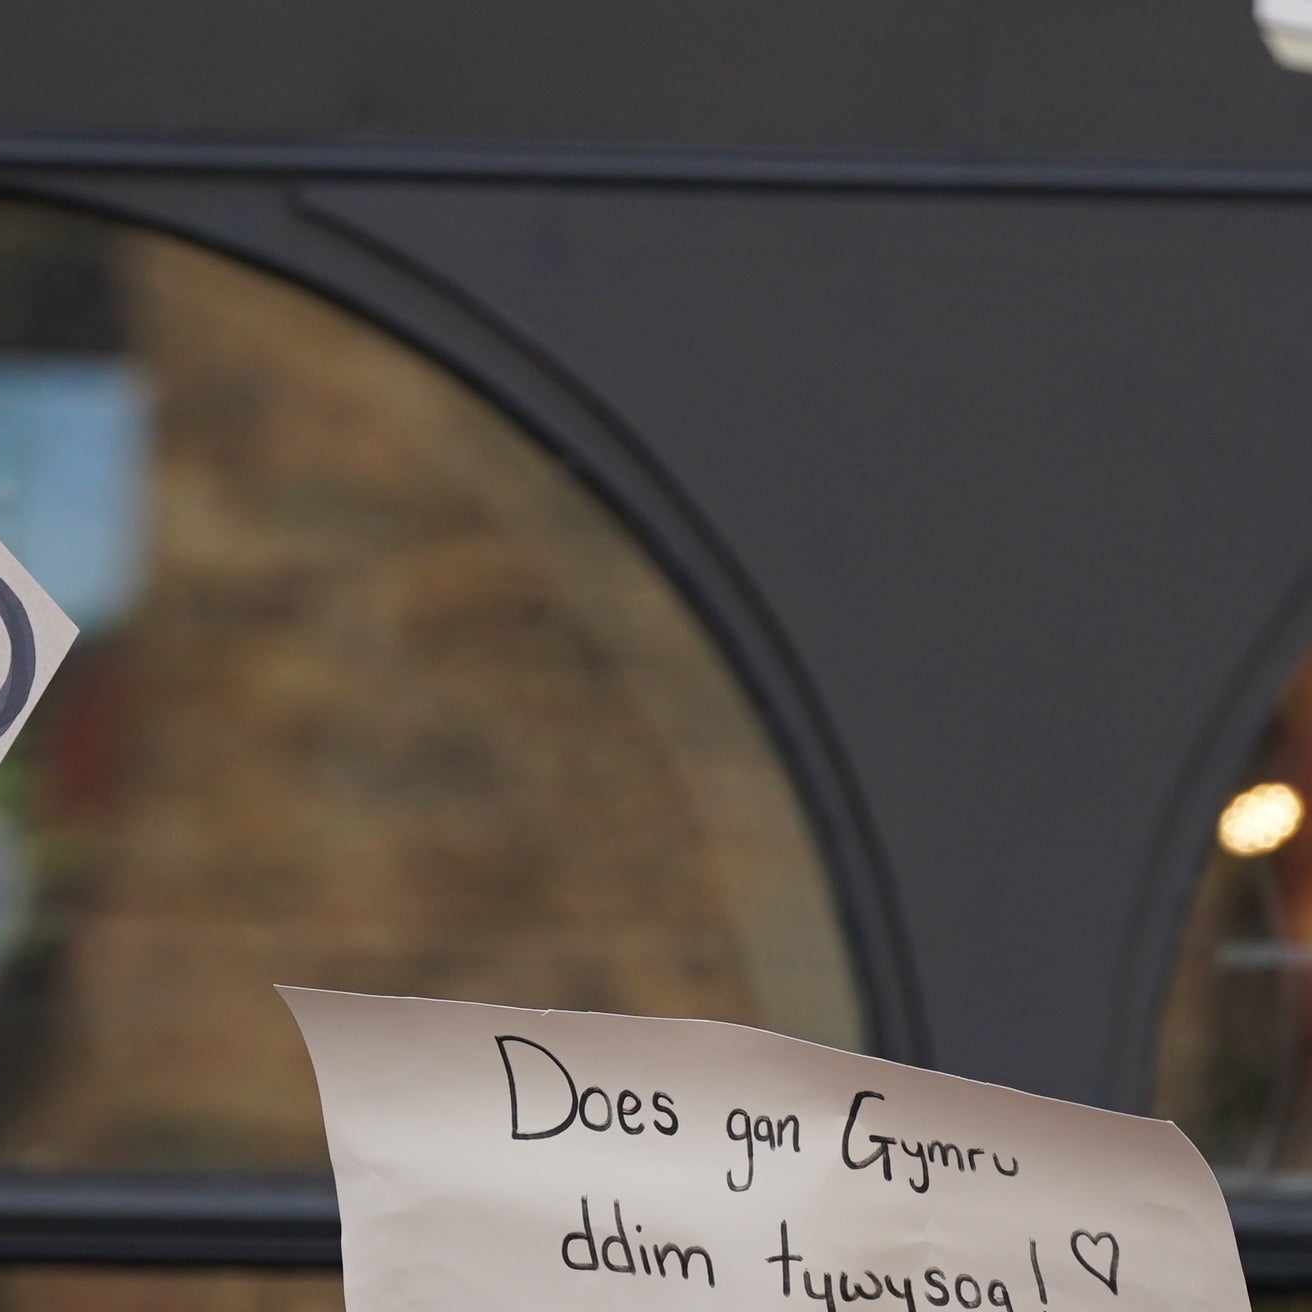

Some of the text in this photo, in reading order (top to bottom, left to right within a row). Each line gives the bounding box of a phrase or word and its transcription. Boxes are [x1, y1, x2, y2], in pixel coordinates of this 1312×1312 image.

[494, 1034, 1020, 1194] Does gan Gymru
[561, 1194, 716, 1289] ddim
